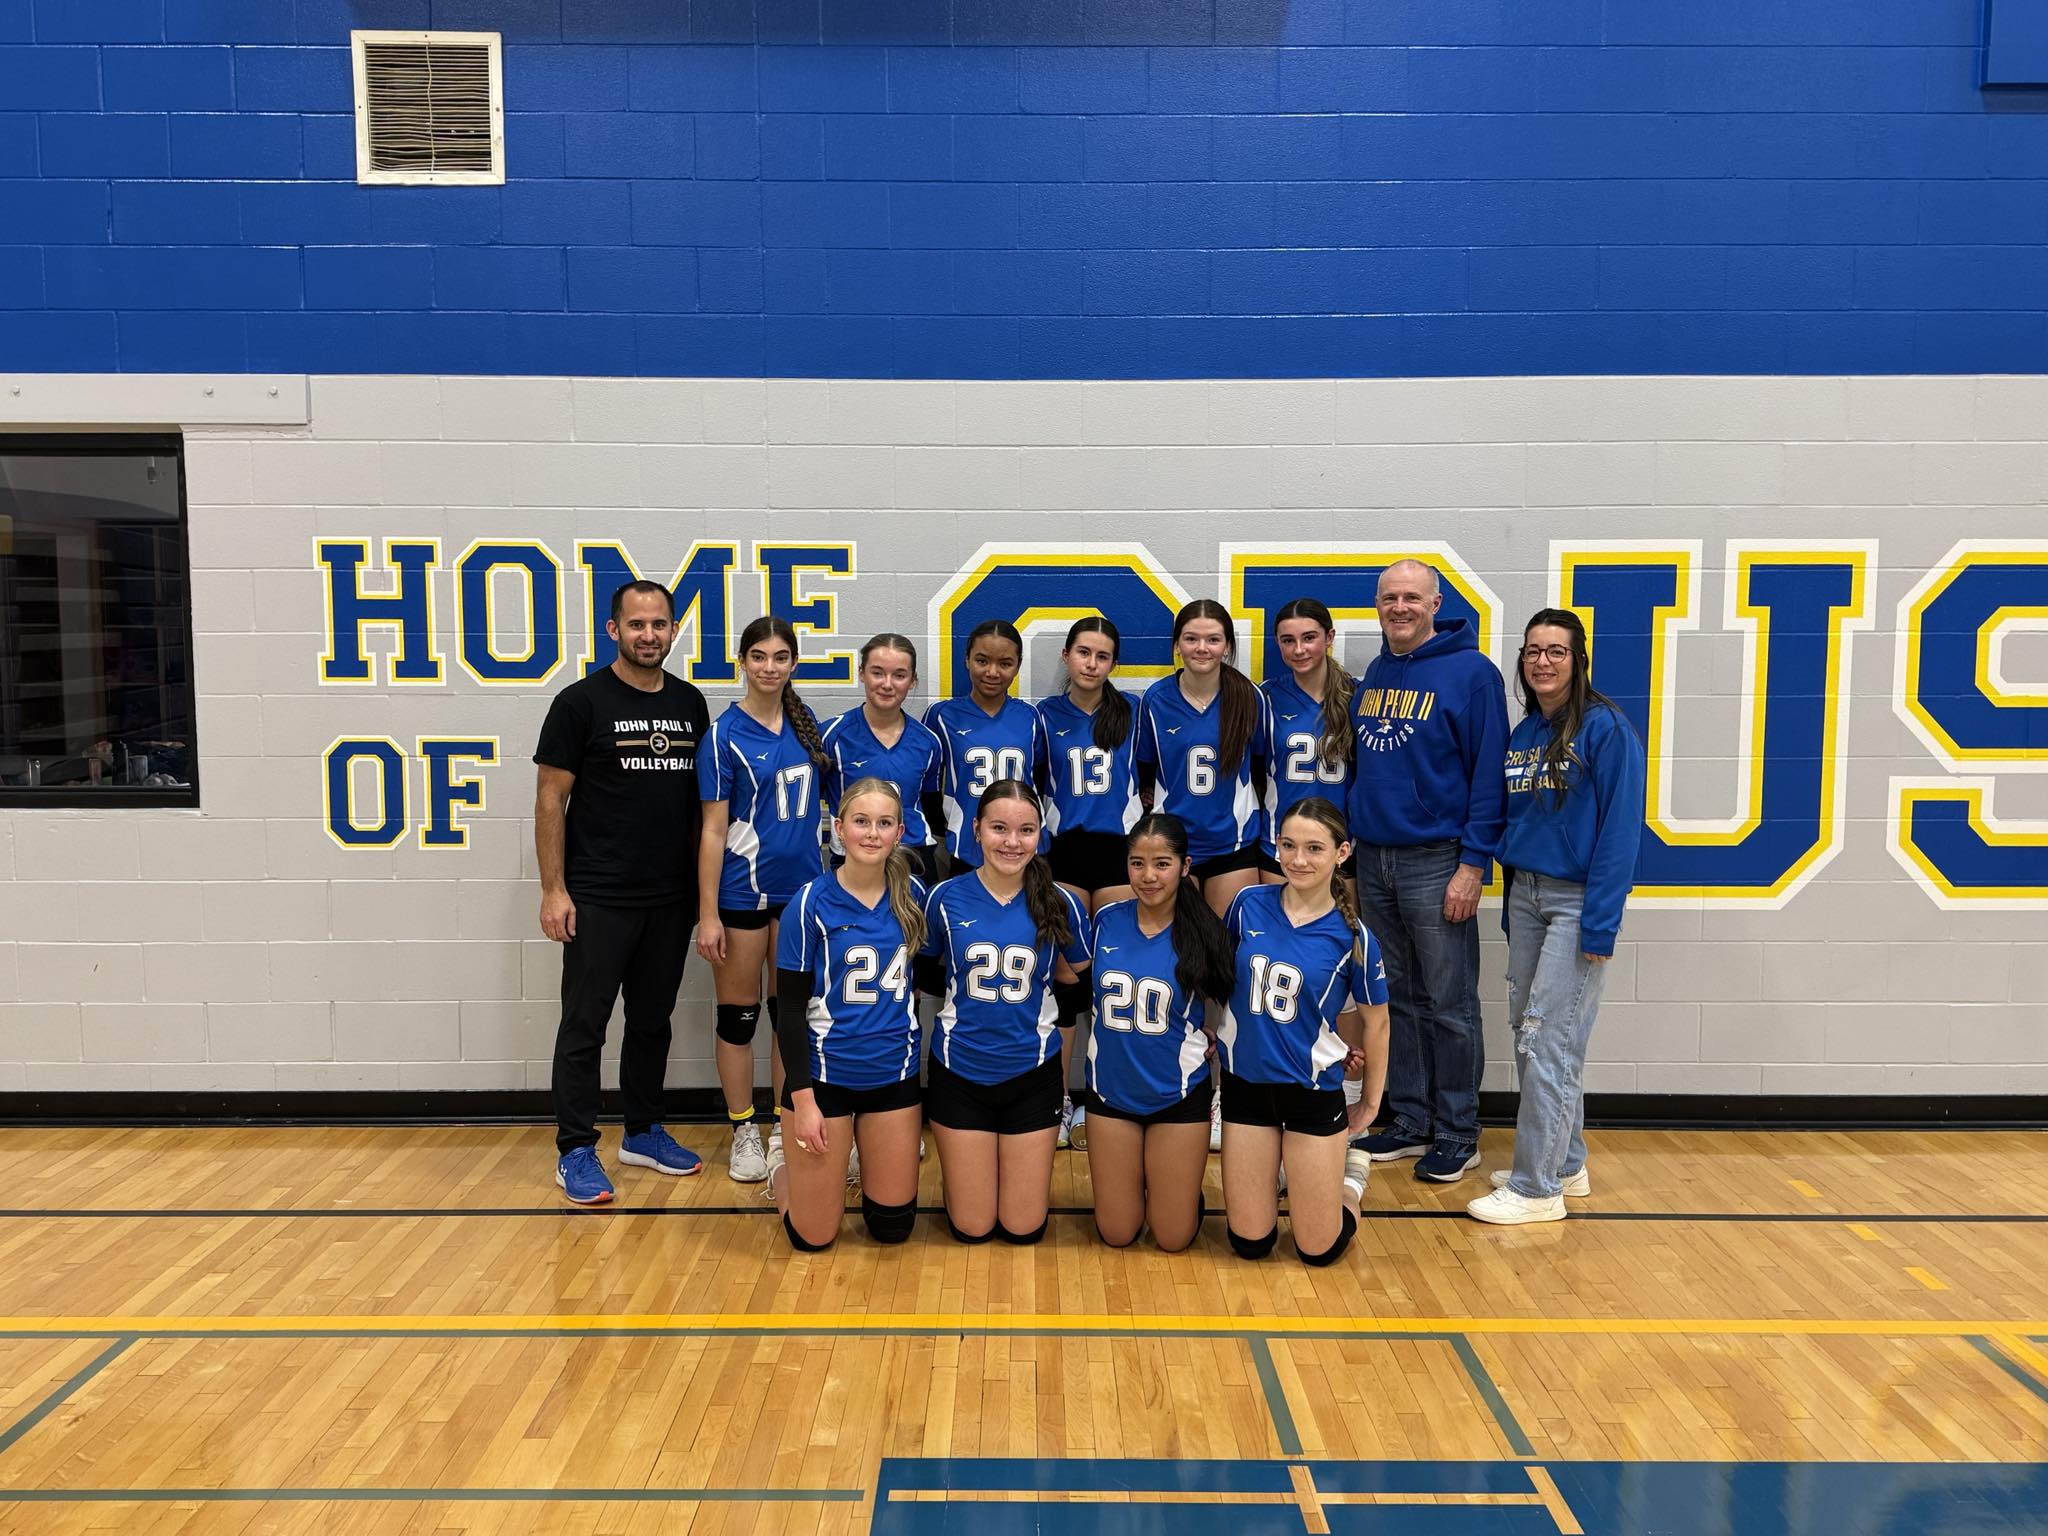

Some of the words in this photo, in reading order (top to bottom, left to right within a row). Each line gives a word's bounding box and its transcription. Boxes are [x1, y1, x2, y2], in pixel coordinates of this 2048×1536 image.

[313, 536, 858, 688] HOME
[614, 719, 649, 732] JOHN
[652, 719, 684, 732] PAUL
[684, 721, 693, 733] II
[1357, 723, 1415, 752] ATHLETICS
[1503, 741, 1576, 767] CRUSA
[620, 757, 694, 770] VOLLEYBALL
[964, 746, 1025, 798] 30
[1067, 746, 1114, 797] 13
[1187, 744, 1217, 796] 6
[321, 734, 501, 851] OF
[775, 762, 813, 822] 17
[842, 943, 909, 1005] 24
[964, 941, 1038, 1005] 29
[1249, 954, 1304, 1024] 18
[1101, 969, 1174, 1036] 20
